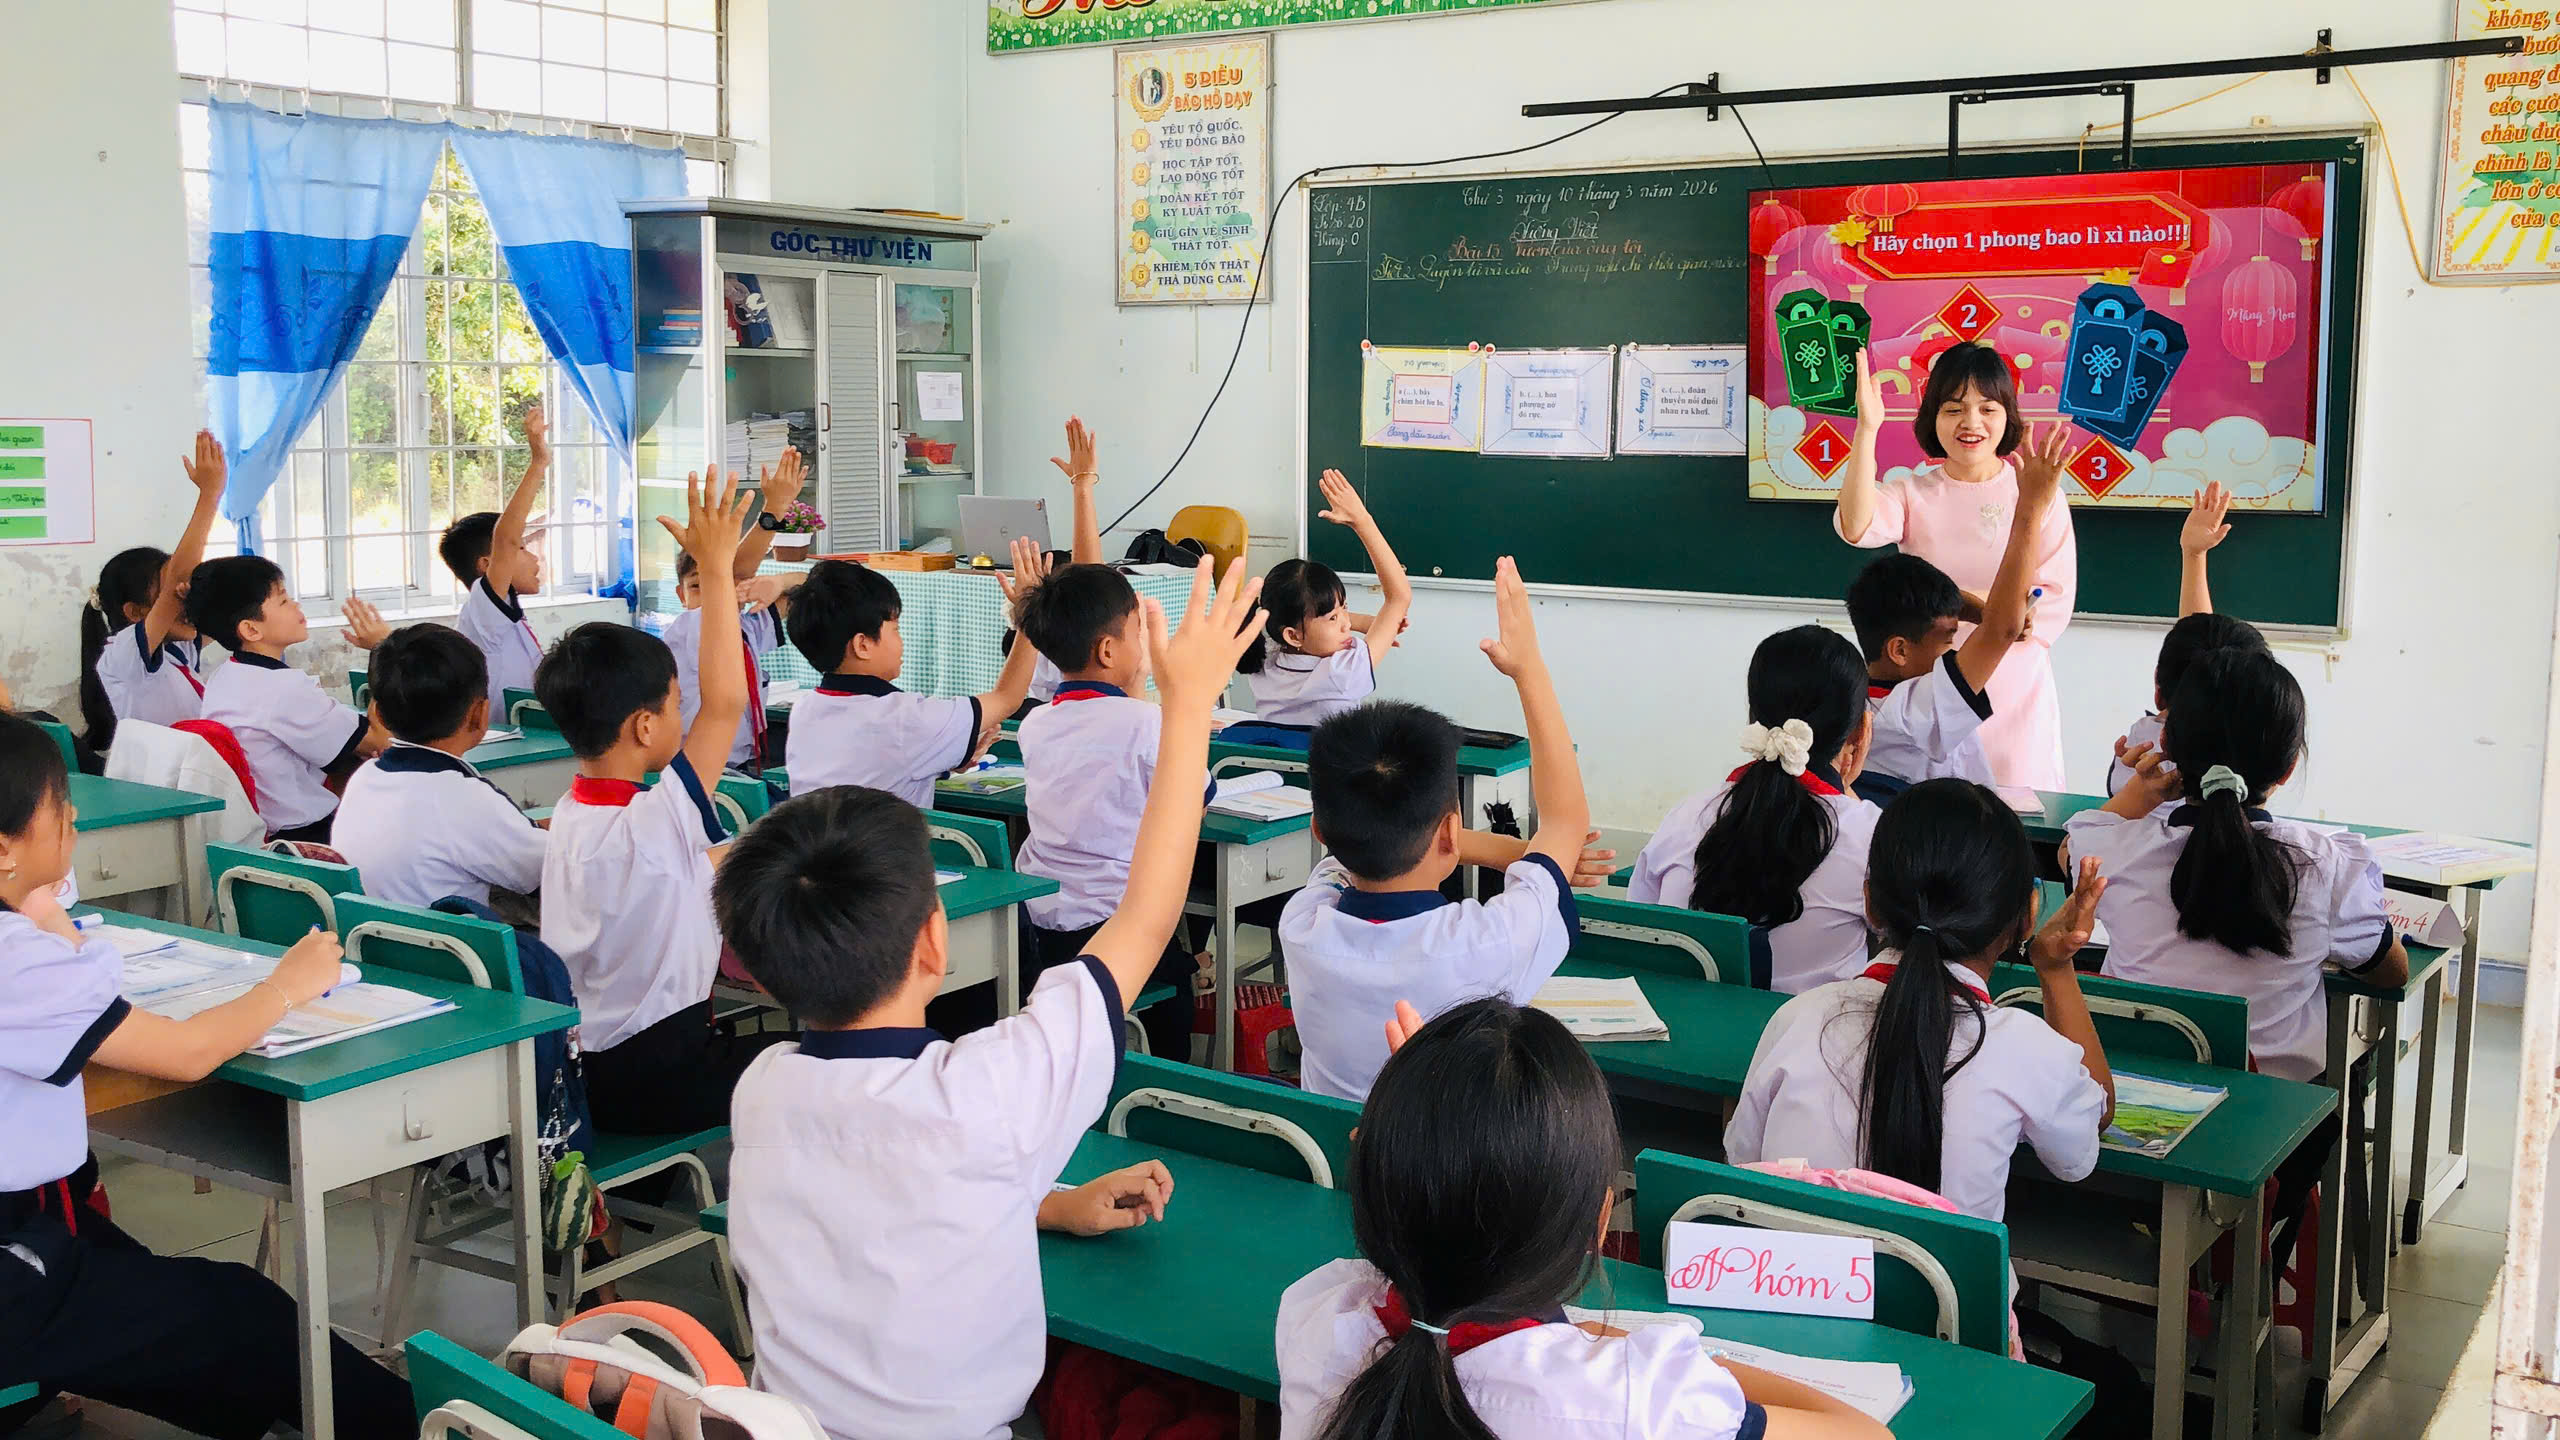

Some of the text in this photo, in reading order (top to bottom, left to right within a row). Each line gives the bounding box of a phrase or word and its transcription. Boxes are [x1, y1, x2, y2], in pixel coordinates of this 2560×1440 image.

[2485, 8, 2550, 31] không,
[1184, 71, 1197, 88] 5
[2484, 69, 2545, 92] quang
[1174, 88, 1253, 112] BÁC HỒ DẠY
[2489, 96, 2523, 116] các
[1162, 123, 1184, 135] YÊU
[2481, 124, 2528, 144] châu
[1160, 133, 1245, 148] YÊU ĐỒNG BÀO
[1163, 153, 1242, 171] HỌC TẬP TỐT.
[2475, 152, 2528, 174] chính
[2532, 151, 2551, 171] là
[1160, 167, 1244, 184] LAO ĐỘNG TỐT
[1160, 187, 1244, 204] ĐOÀN KẾT TỐT
[1462, 179, 1720, 216] Thứ 3 ngày 10 tháng 3 năm 2026
[2491, 180, 2523, 201] lớn
[2528, 178, 2543, 199] ở
[1215, 201, 1241, 214] TỐT.
[1348, 215, 1364, 228] 20
[2511, 207, 2545, 228] của
[1178, 226, 1198, 237] GÌN
[1222, 225, 1249, 235] SINH
[1351, 232, 1360, 246] 0
[1873, 224, 2189, 255] Hãy chọn 1 phong bao lì xì nào!!!
[770, 227, 932, 264] GÓC THƯ VIỆN
[1137, 237, 1144, 246] 4
[1206, 237, 1232, 250] TỐT.
[1153, 258, 1250, 272] KHIÊM TỐN THẬT
[1138, 270, 1144, 280] 5
[1157, 274, 1180, 285] THÀ
[1183, 274, 1214, 285] DŨNG
[1961, 304, 1977, 328] 2
[1660, 407, 1679, 415] nhau
[1819, 439, 1834, 462] 1
[2090, 456, 2107, 480] 3
[2414, 911, 2429, 933] 4
[1671, 1246, 1873, 1303] Nhóm 5
